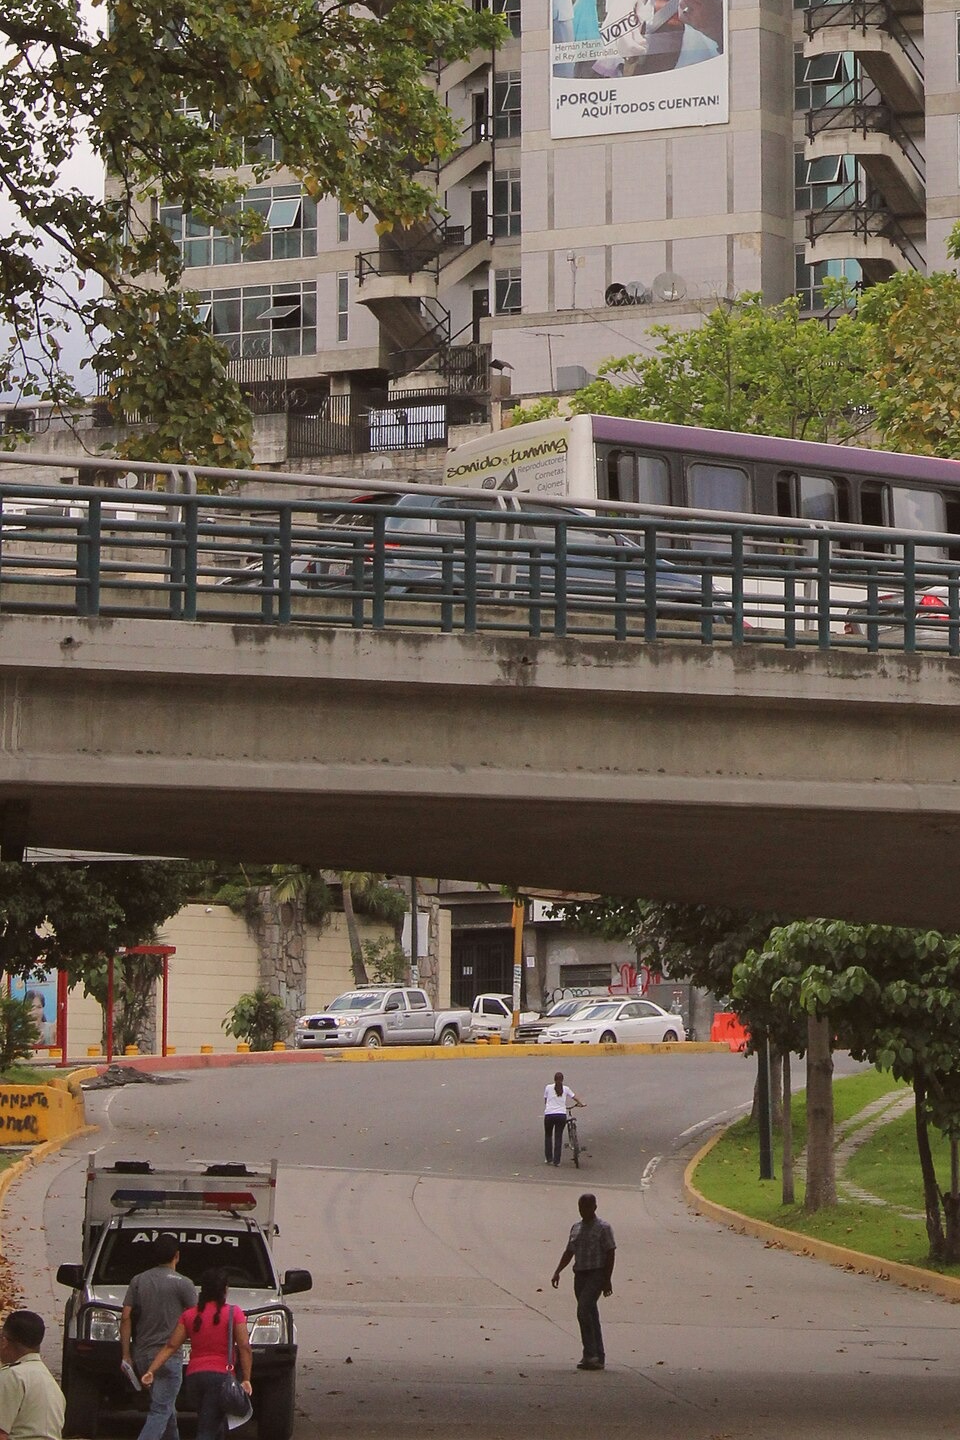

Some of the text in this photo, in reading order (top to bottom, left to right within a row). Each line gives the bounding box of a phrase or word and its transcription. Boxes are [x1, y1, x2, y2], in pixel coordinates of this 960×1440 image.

[563, 52, 575, 61] Rey
[556, 89, 617, 109] ¡PORQUE
[581, 95, 720, 118] AQUÍ TODOS CUENTAN!
[447, 456, 501, 478] sonido
